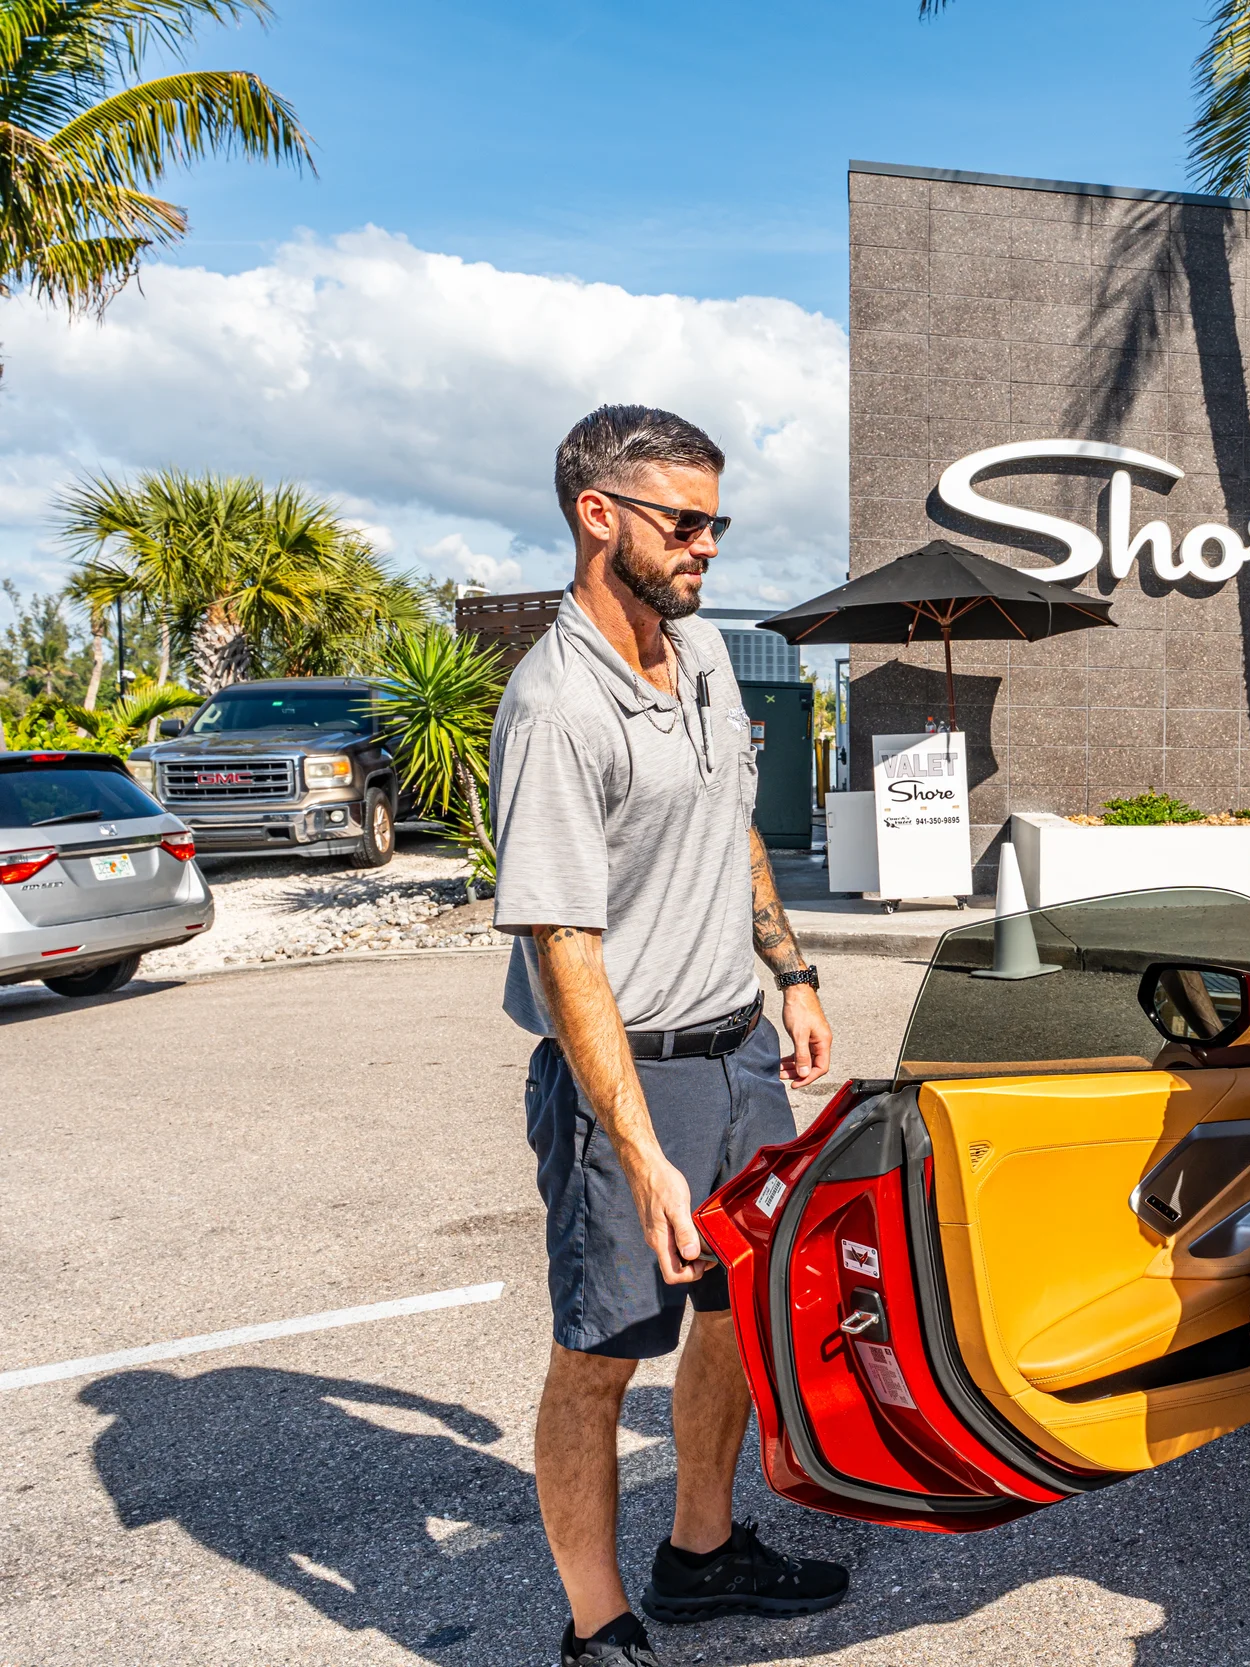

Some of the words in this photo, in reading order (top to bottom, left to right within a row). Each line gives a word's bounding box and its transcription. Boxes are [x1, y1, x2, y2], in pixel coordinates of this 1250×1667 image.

[881, 752, 958, 778] VALET
[197, 772, 253, 784] GMC
[887, 780, 955, 802] Shore
[915, 816, 960, 825] 941-350-9895
